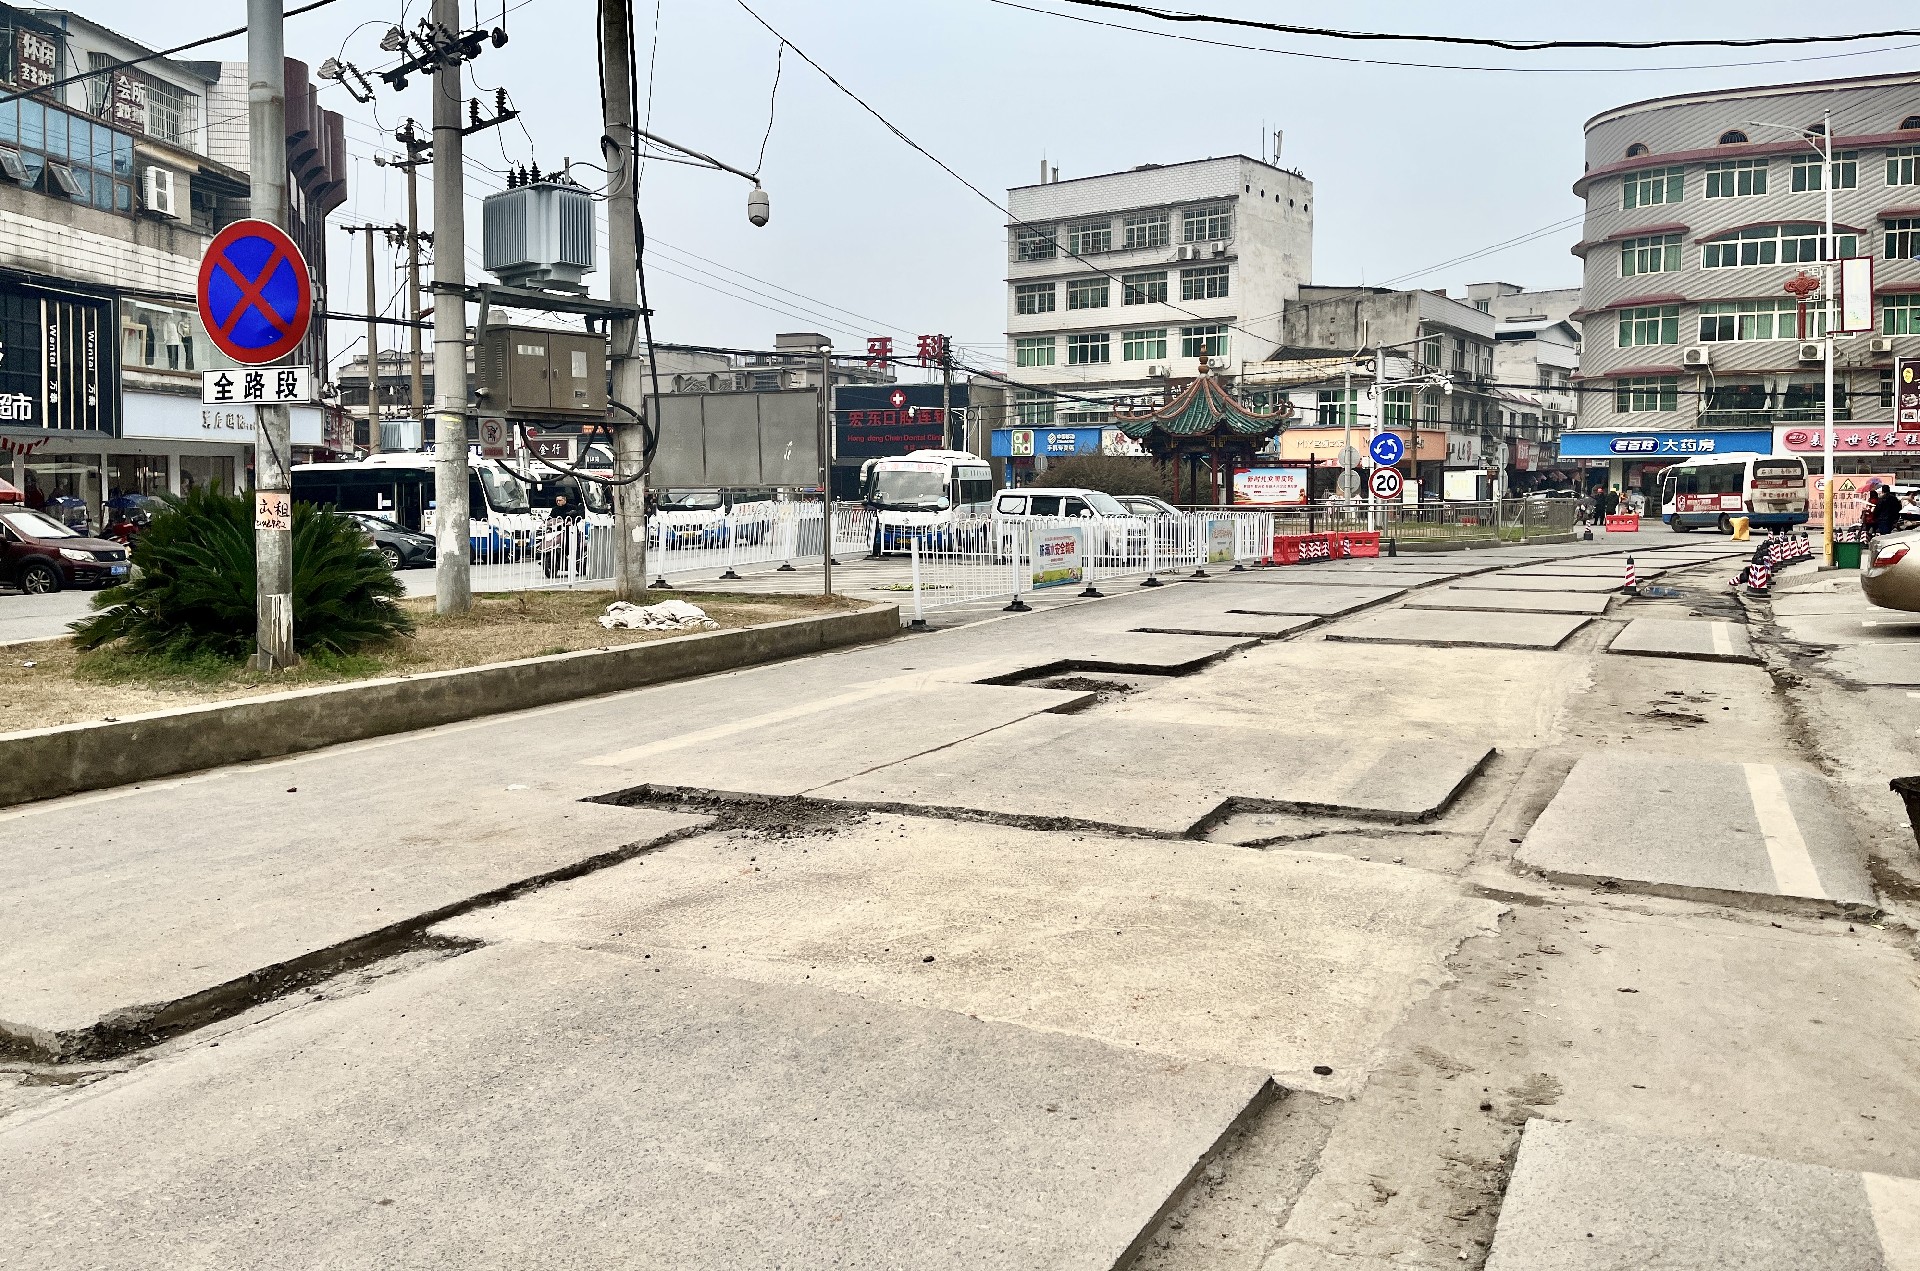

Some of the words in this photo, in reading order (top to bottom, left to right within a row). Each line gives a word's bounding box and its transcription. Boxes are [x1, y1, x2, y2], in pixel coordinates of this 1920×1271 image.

[213, 370, 298, 400] 全路段
[1662, 438, 1715, 452] 大药房
[1376, 474, 1398, 492] 20
[259, 498, 290, 517] 出租
